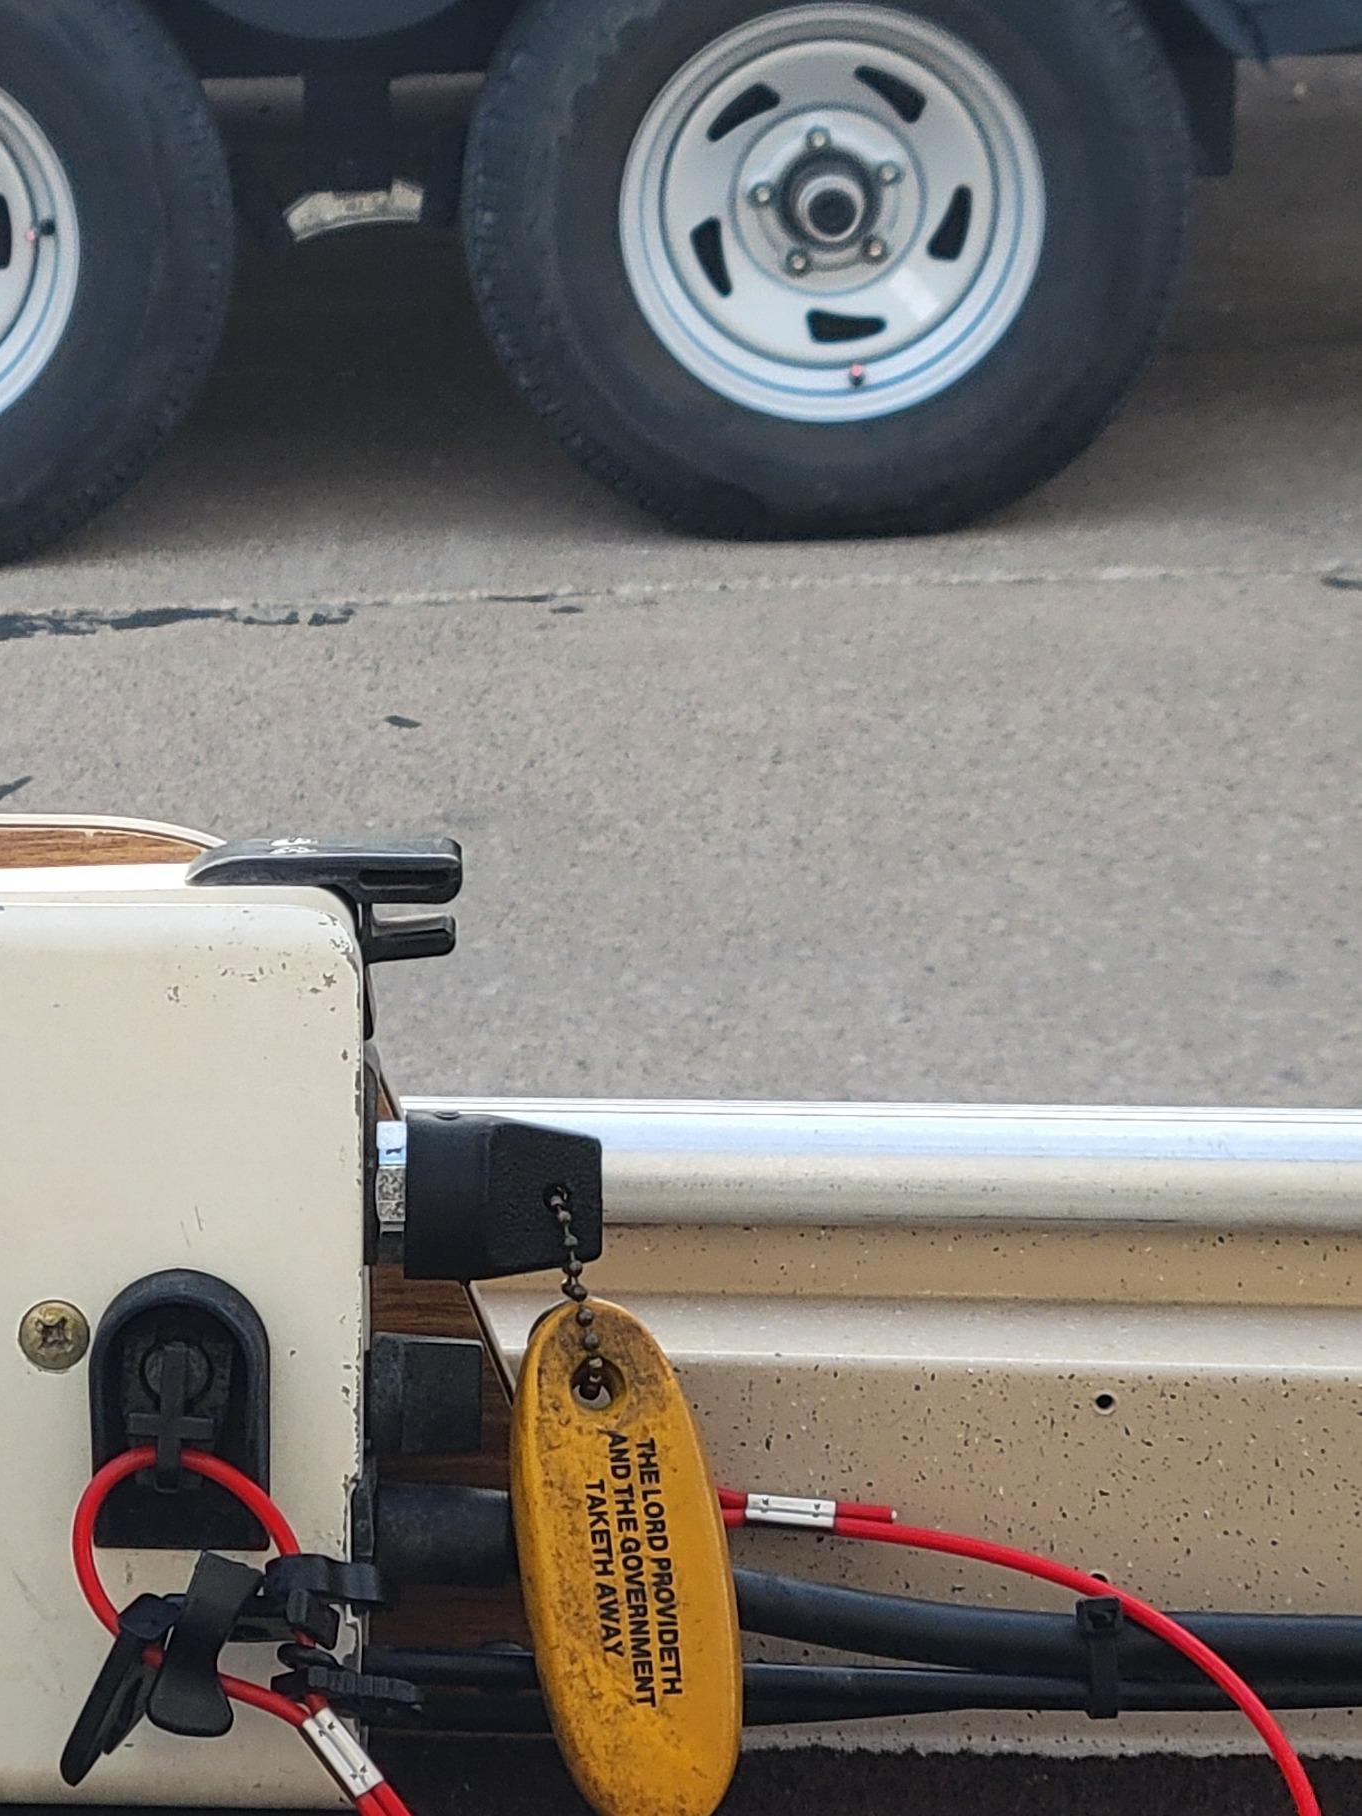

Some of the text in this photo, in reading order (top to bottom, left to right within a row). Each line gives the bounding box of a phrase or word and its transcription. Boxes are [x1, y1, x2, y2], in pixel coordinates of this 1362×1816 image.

[585, 1479, 624, 1658] TAKETH AWAY
[608, 1434, 656, 1707] AND THE GOVERNMENT
[636, 1437, 683, 1695] THE LORD PROVIDETH
